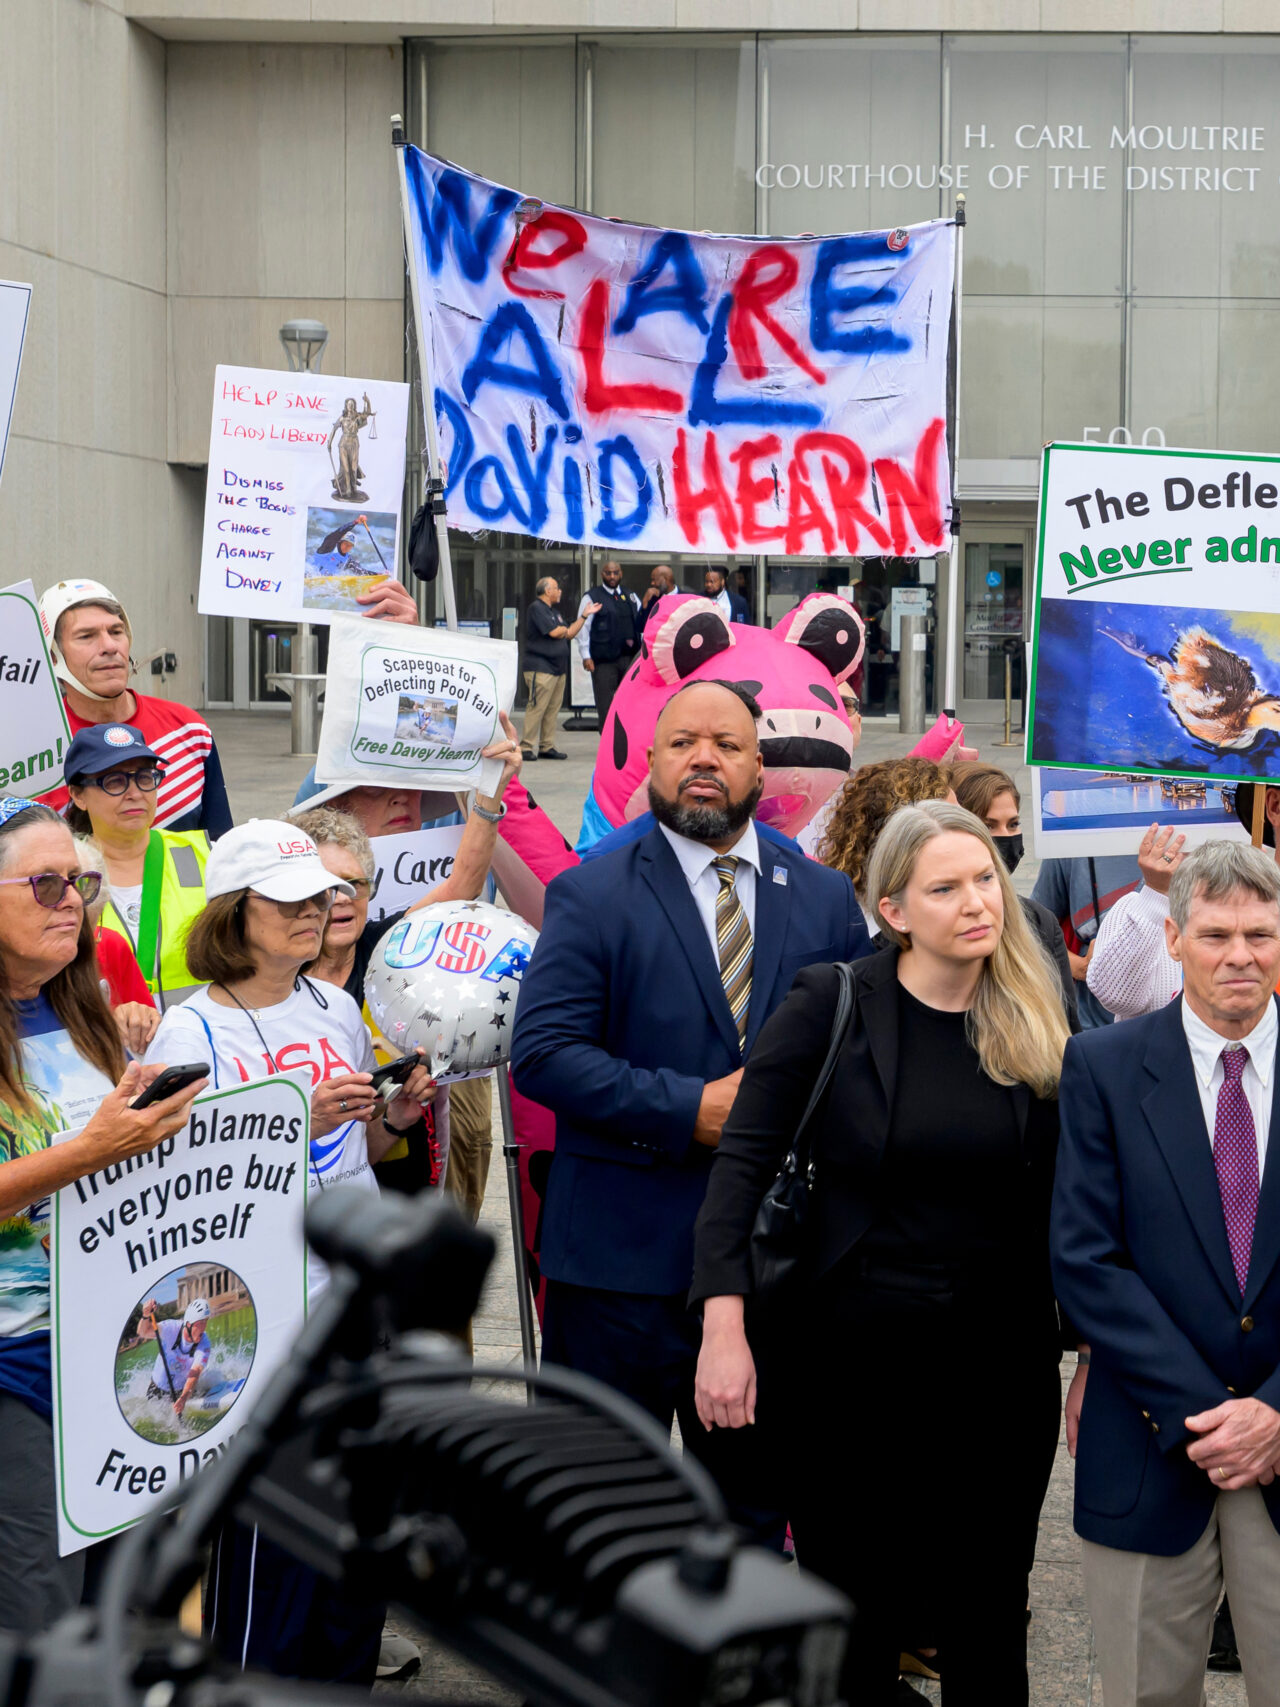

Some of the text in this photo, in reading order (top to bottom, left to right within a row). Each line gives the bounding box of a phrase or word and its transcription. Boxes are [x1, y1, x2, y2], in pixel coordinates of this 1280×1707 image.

[965, 124, 995, 149] H.
[1015, 125, 1091, 149] CARL
[1110, 125, 1265, 151] MOULTRIE
[755, 163, 970, 190] COURTHOUSE
[988, 165, 1030, 189] OF
[1048, 166, 1106, 190] THE
[1127, 166, 1260, 193] DISTRICT
[460, 277, 826, 427] ALL
[222, 380, 329, 413] HELP SAVE
[270, 424, 328, 446] LIBERTY
[217, 492, 248, 508] THE
[671, 416, 946, 557] HEARN
[1065, 488, 1150, 529] The
[217, 519, 272, 536] CHARGE
[216, 542, 275, 561] AGAINST
[1059, 534, 1193, 586] Never
[225, 567, 282, 593] DAVEY
[382, 658, 477, 685] Scapegoat for
[364, 675, 494, 717] Deflecting Pool fail
[353, 737, 481, 762] Free Davey Hearn!
[277, 839, 317, 854] USA
[384, 921, 534, 983] USA
[233, 1037, 357, 1087] USA
[189, 1110, 303, 1149] blames
[78, 1154, 297, 1254] everyone but
[124, 1203, 256, 1275] himself
[96, 1447, 168, 1496] Free
